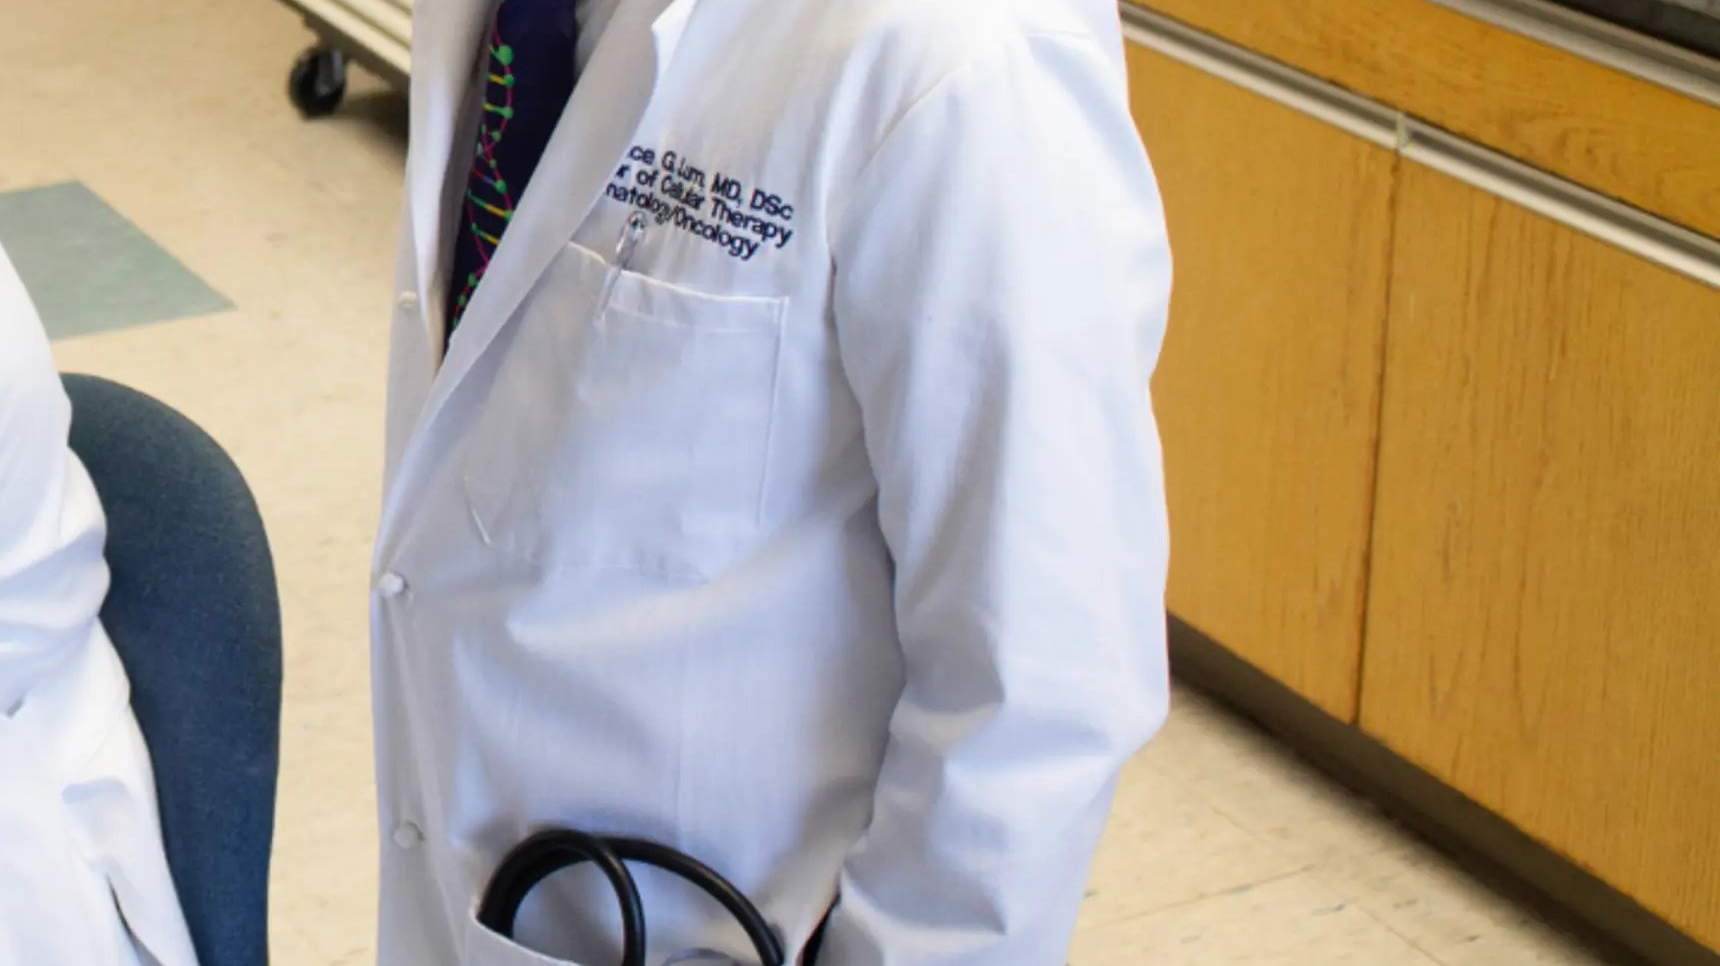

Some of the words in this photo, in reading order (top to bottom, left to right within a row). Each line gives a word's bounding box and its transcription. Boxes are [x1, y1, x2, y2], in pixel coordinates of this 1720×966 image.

[636, 169, 659, 187] of
[711, 196, 794, 249] Therapy
[710, 172, 743, 208] MD,
[750, 188, 794, 221] DSc
